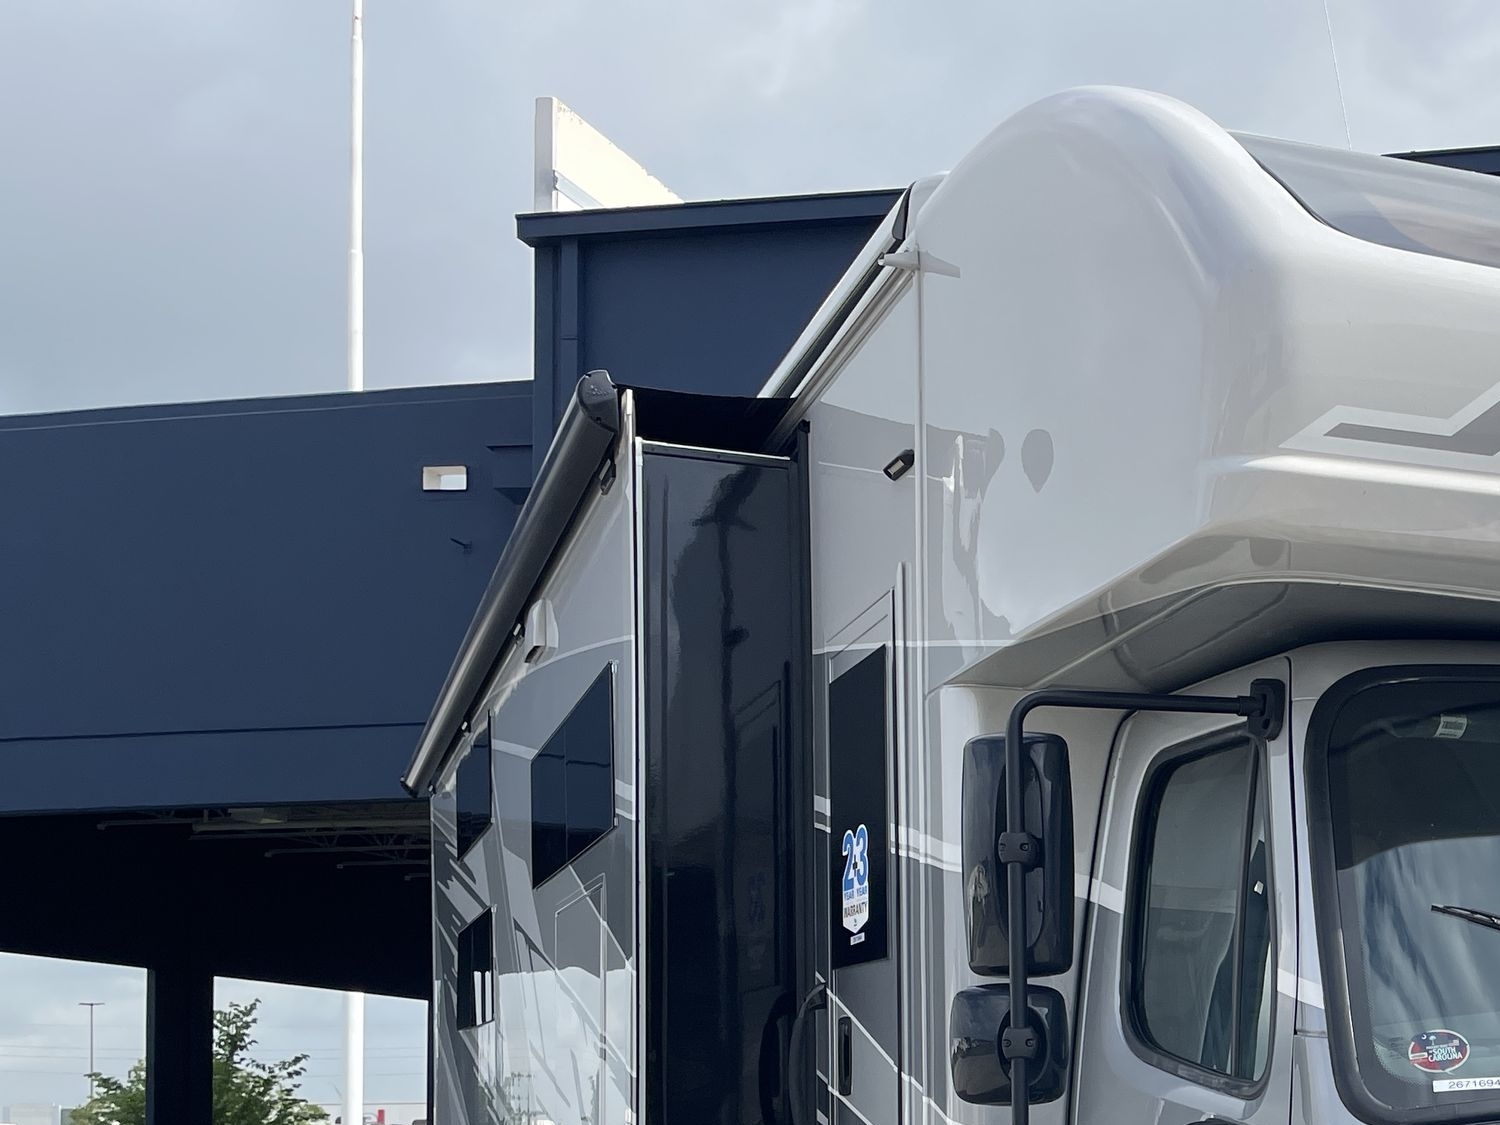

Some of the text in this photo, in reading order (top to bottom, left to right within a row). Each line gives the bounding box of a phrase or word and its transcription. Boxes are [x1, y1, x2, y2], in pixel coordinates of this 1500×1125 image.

[844, 901, 868, 918] WARRANTY
[1432, 1046, 1456, 1055] SOUTH
[1428, 1052, 1463, 1062] CAROLINA
[1448, 1079, 1500, 1089] 2671694
